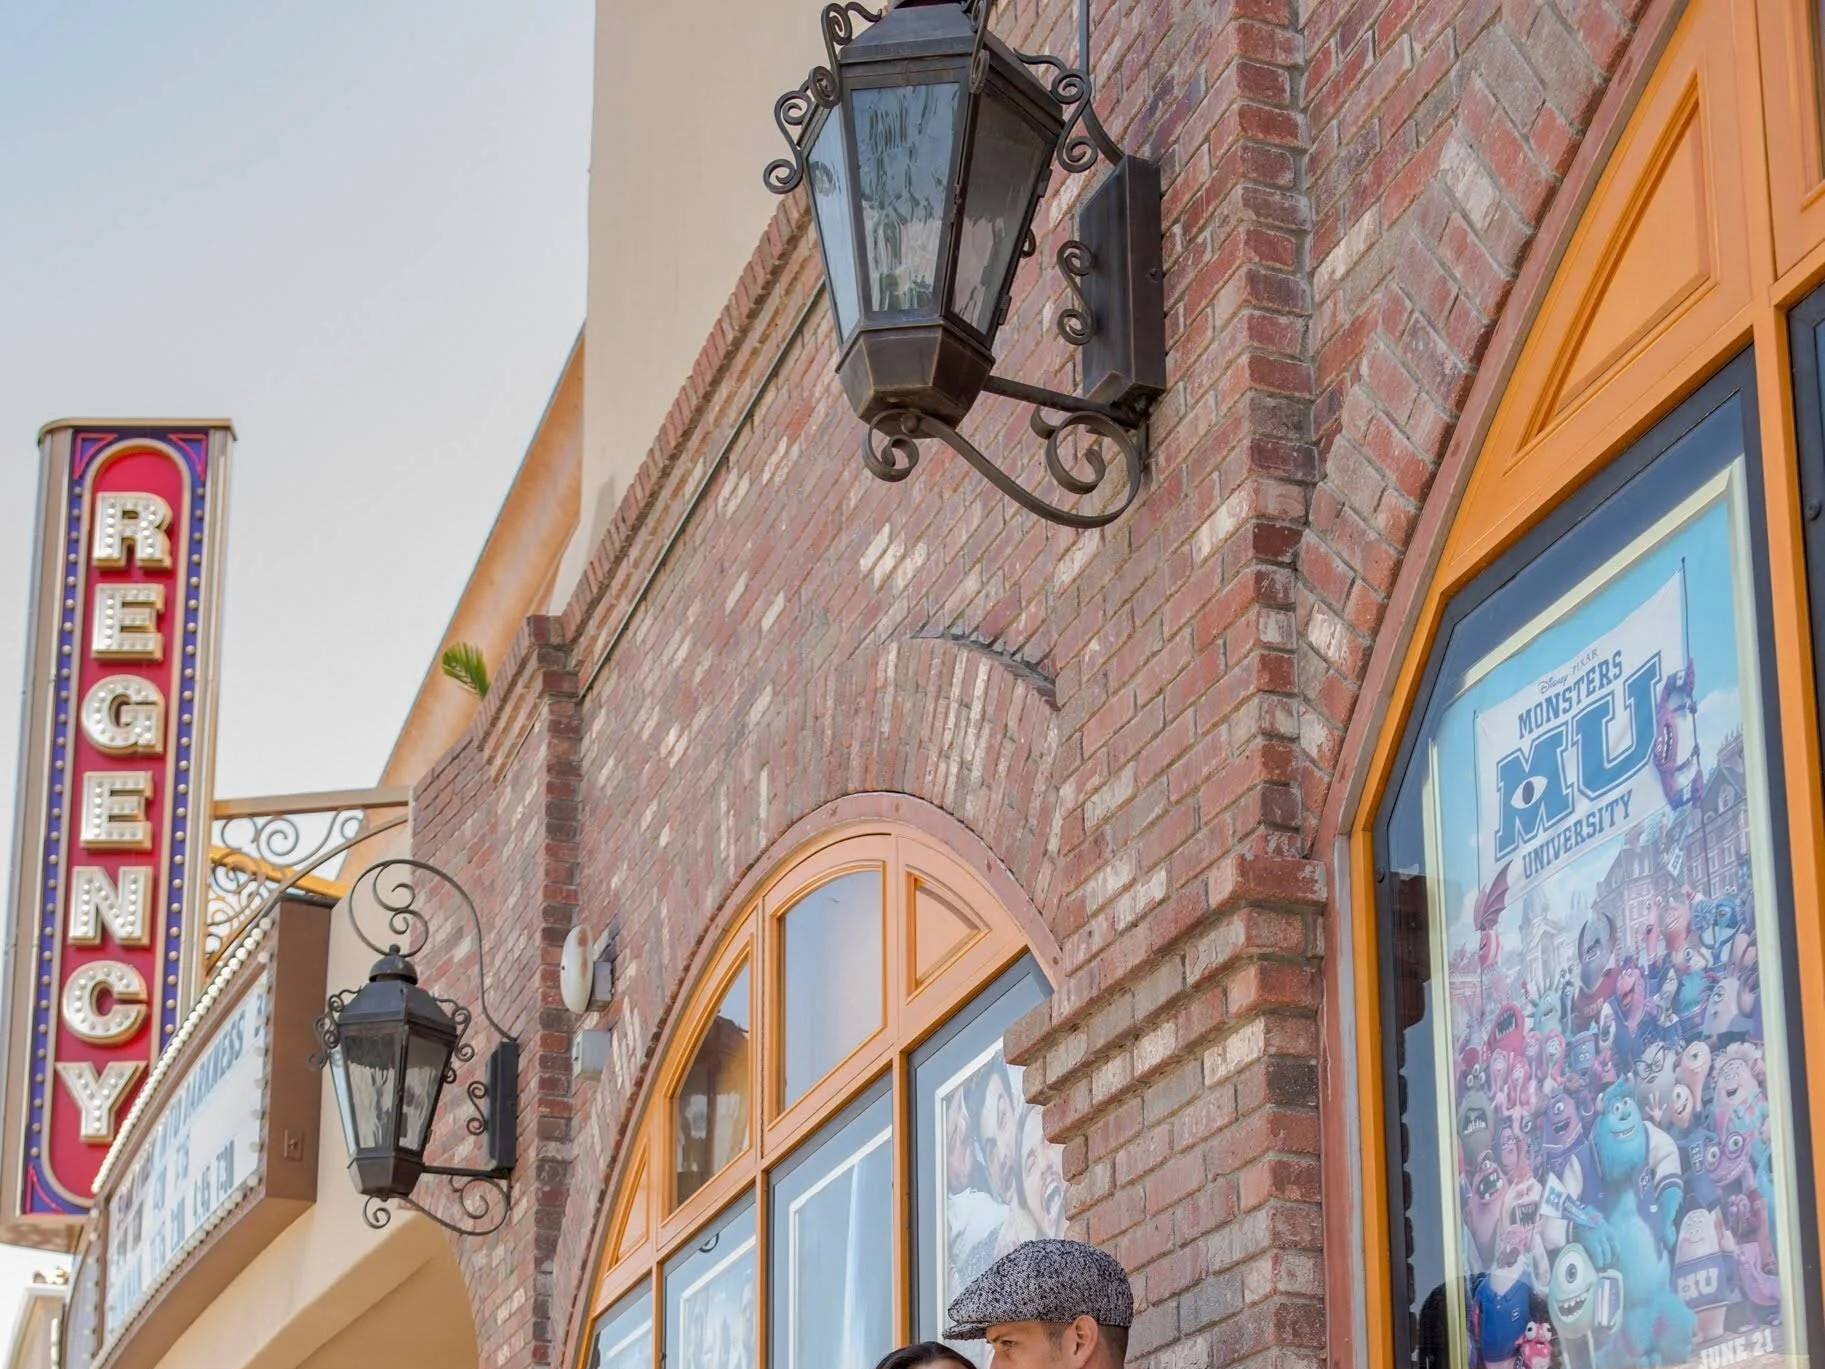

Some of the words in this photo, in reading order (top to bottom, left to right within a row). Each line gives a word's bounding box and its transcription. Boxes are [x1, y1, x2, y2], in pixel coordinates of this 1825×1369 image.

[1518, 649, 1622, 740] MONSTERS
[1538, 674, 1568, 694] Disney
[1571, 648, 1600, 676] PIXAR
[1495, 650, 1662, 862] MU
[55, 491, 172, 1142] REGENCY
[1522, 788, 1632, 880] UNIVERSITY
[1752, 1327, 1774, 1356] 21
